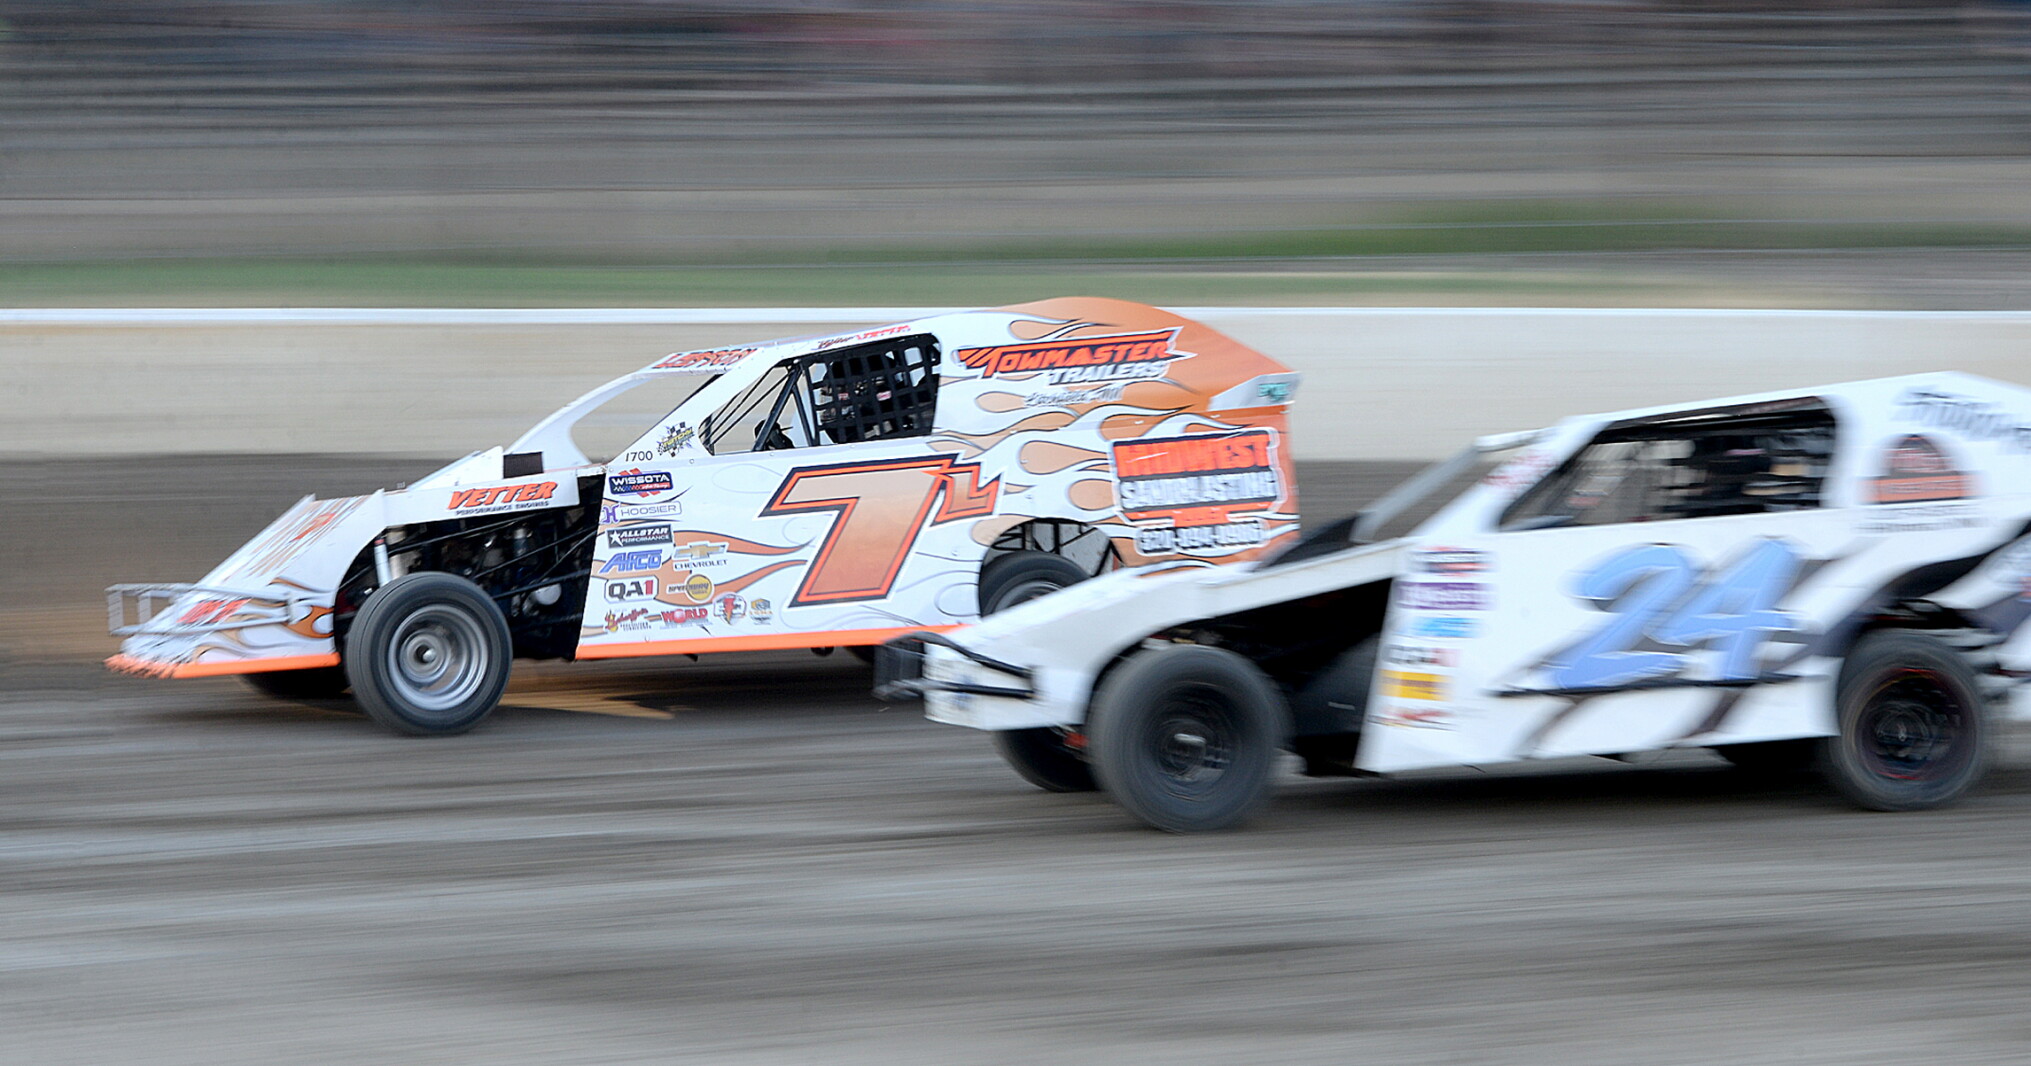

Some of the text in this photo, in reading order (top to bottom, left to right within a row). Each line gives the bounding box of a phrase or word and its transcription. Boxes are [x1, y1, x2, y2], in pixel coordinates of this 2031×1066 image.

[958, 329, 1176, 378] TOWMASTER
[1048, 361, 1169, 386] TRAILERS
[625, 451, 653, 462] 1700
[611, 474, 670, 485] WISSOTA
[447, 481, 558, 510] VETTER
[620, 504, 676, 517] HOOSIER
[620, 527, 669, 539] ALLSTAR
[599, 549, 663, 574] AFCO
[674, 559, 727, 570] CHEVROLET
[608, 580, 654, 600] QA1
[661, 608, 708, 624] WORLD
[1552, 538, 1800, 690] 24
